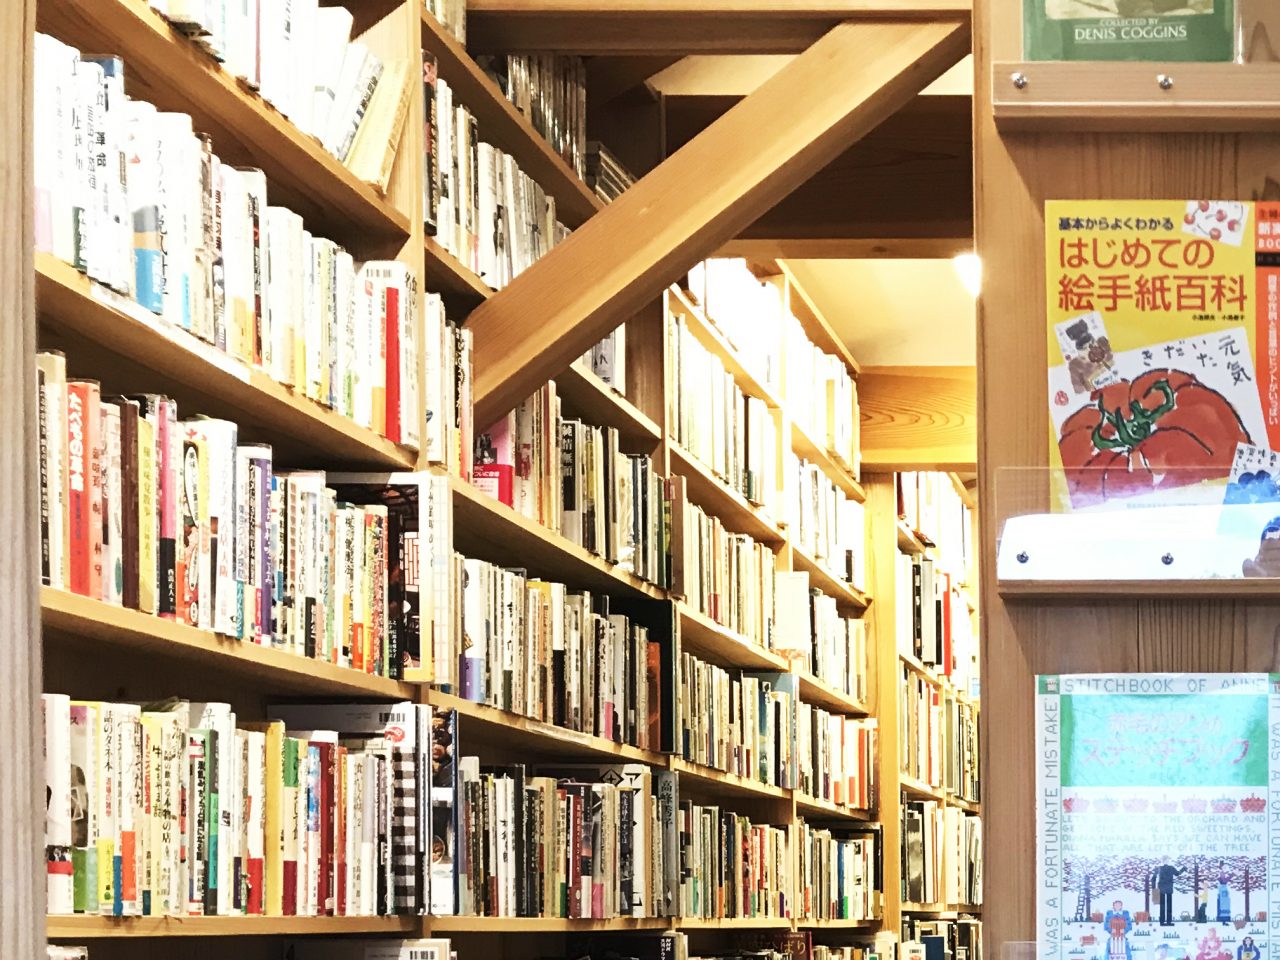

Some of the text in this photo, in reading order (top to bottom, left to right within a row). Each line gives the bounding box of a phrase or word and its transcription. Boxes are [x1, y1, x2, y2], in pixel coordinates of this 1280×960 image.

[1098, 17, 1160, 27] COLLECTED BY
[1074, 25, 1188, 41] DENIS COGGINS
[1058, 216, 1174, 232] 基本からよくわかる
[1058, 237, 1216, 269] はじめての
[1057, 274, 1248, 312] 絵手紙百科
[1064, 678, 1174, 693] STITCHBOOK
[1187, 678, 1208, 693] OF
[1242, 815, 1266, 824] AND
[1044, 787, 1059, 890] FORTUNATE
[1206, 834, 1230, 843] CAN
[1233, 834, 1263, 843] HAVE
[1198, 844, 1219, 853] THE
[1044, 897, 1059, 908] A
[1043, 917, 1058, 957] WAS
